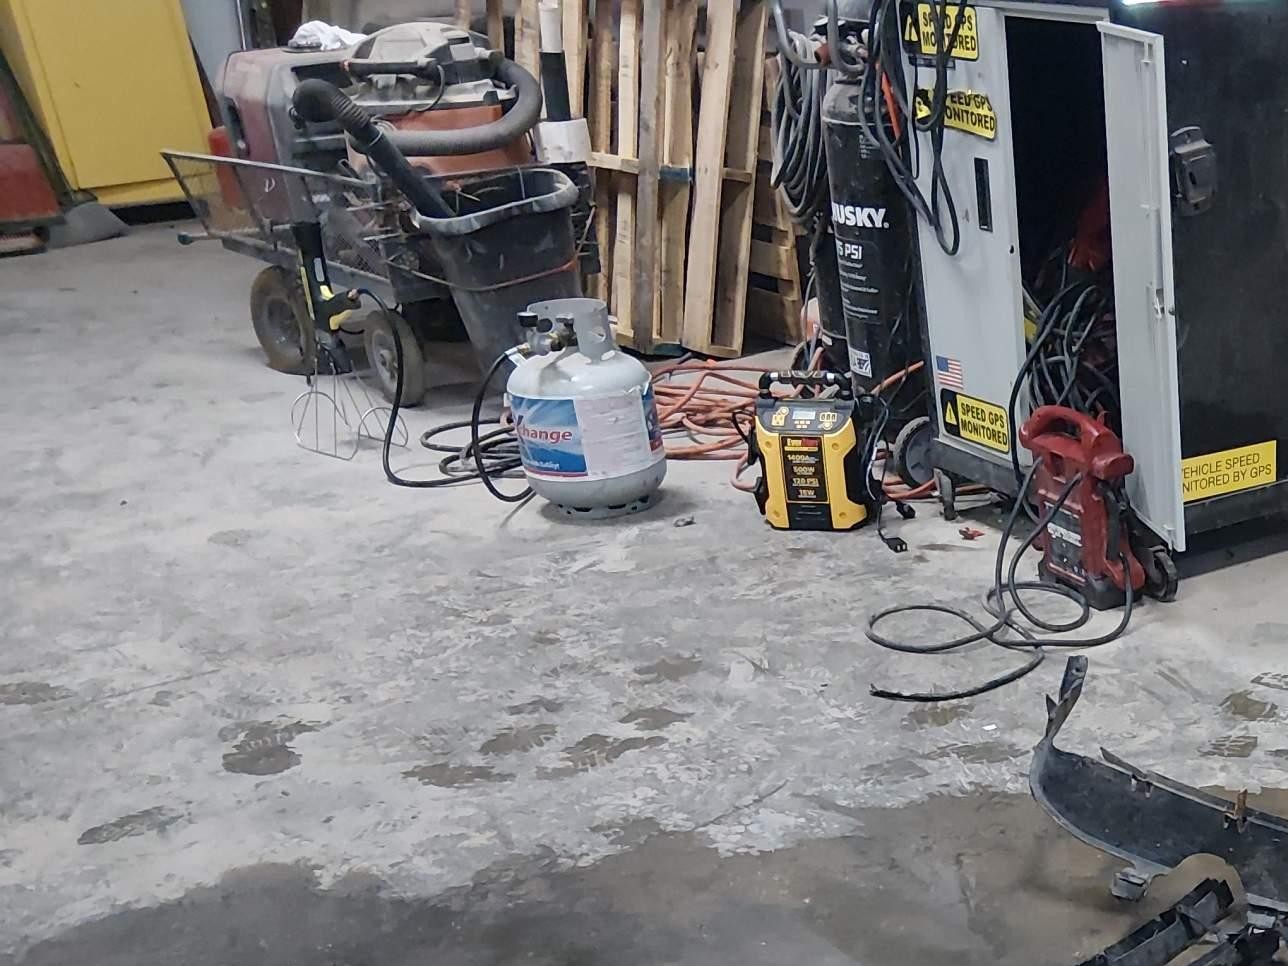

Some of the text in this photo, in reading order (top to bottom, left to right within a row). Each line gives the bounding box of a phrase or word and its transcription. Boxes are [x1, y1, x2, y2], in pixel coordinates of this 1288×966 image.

[922, 11, 952, 30] SPD
[945, 107, 995, 132] ONITORED
[844, 243, 863, 260] PSI
[960, 402, 1005, 429] SPEED GPS
[960, 418, 1008, 446] MONITORED
[1182, 453, 1260, 479] EHICLE SPEED
[1183, 464, 1272, 494] NITORED BY GPS
